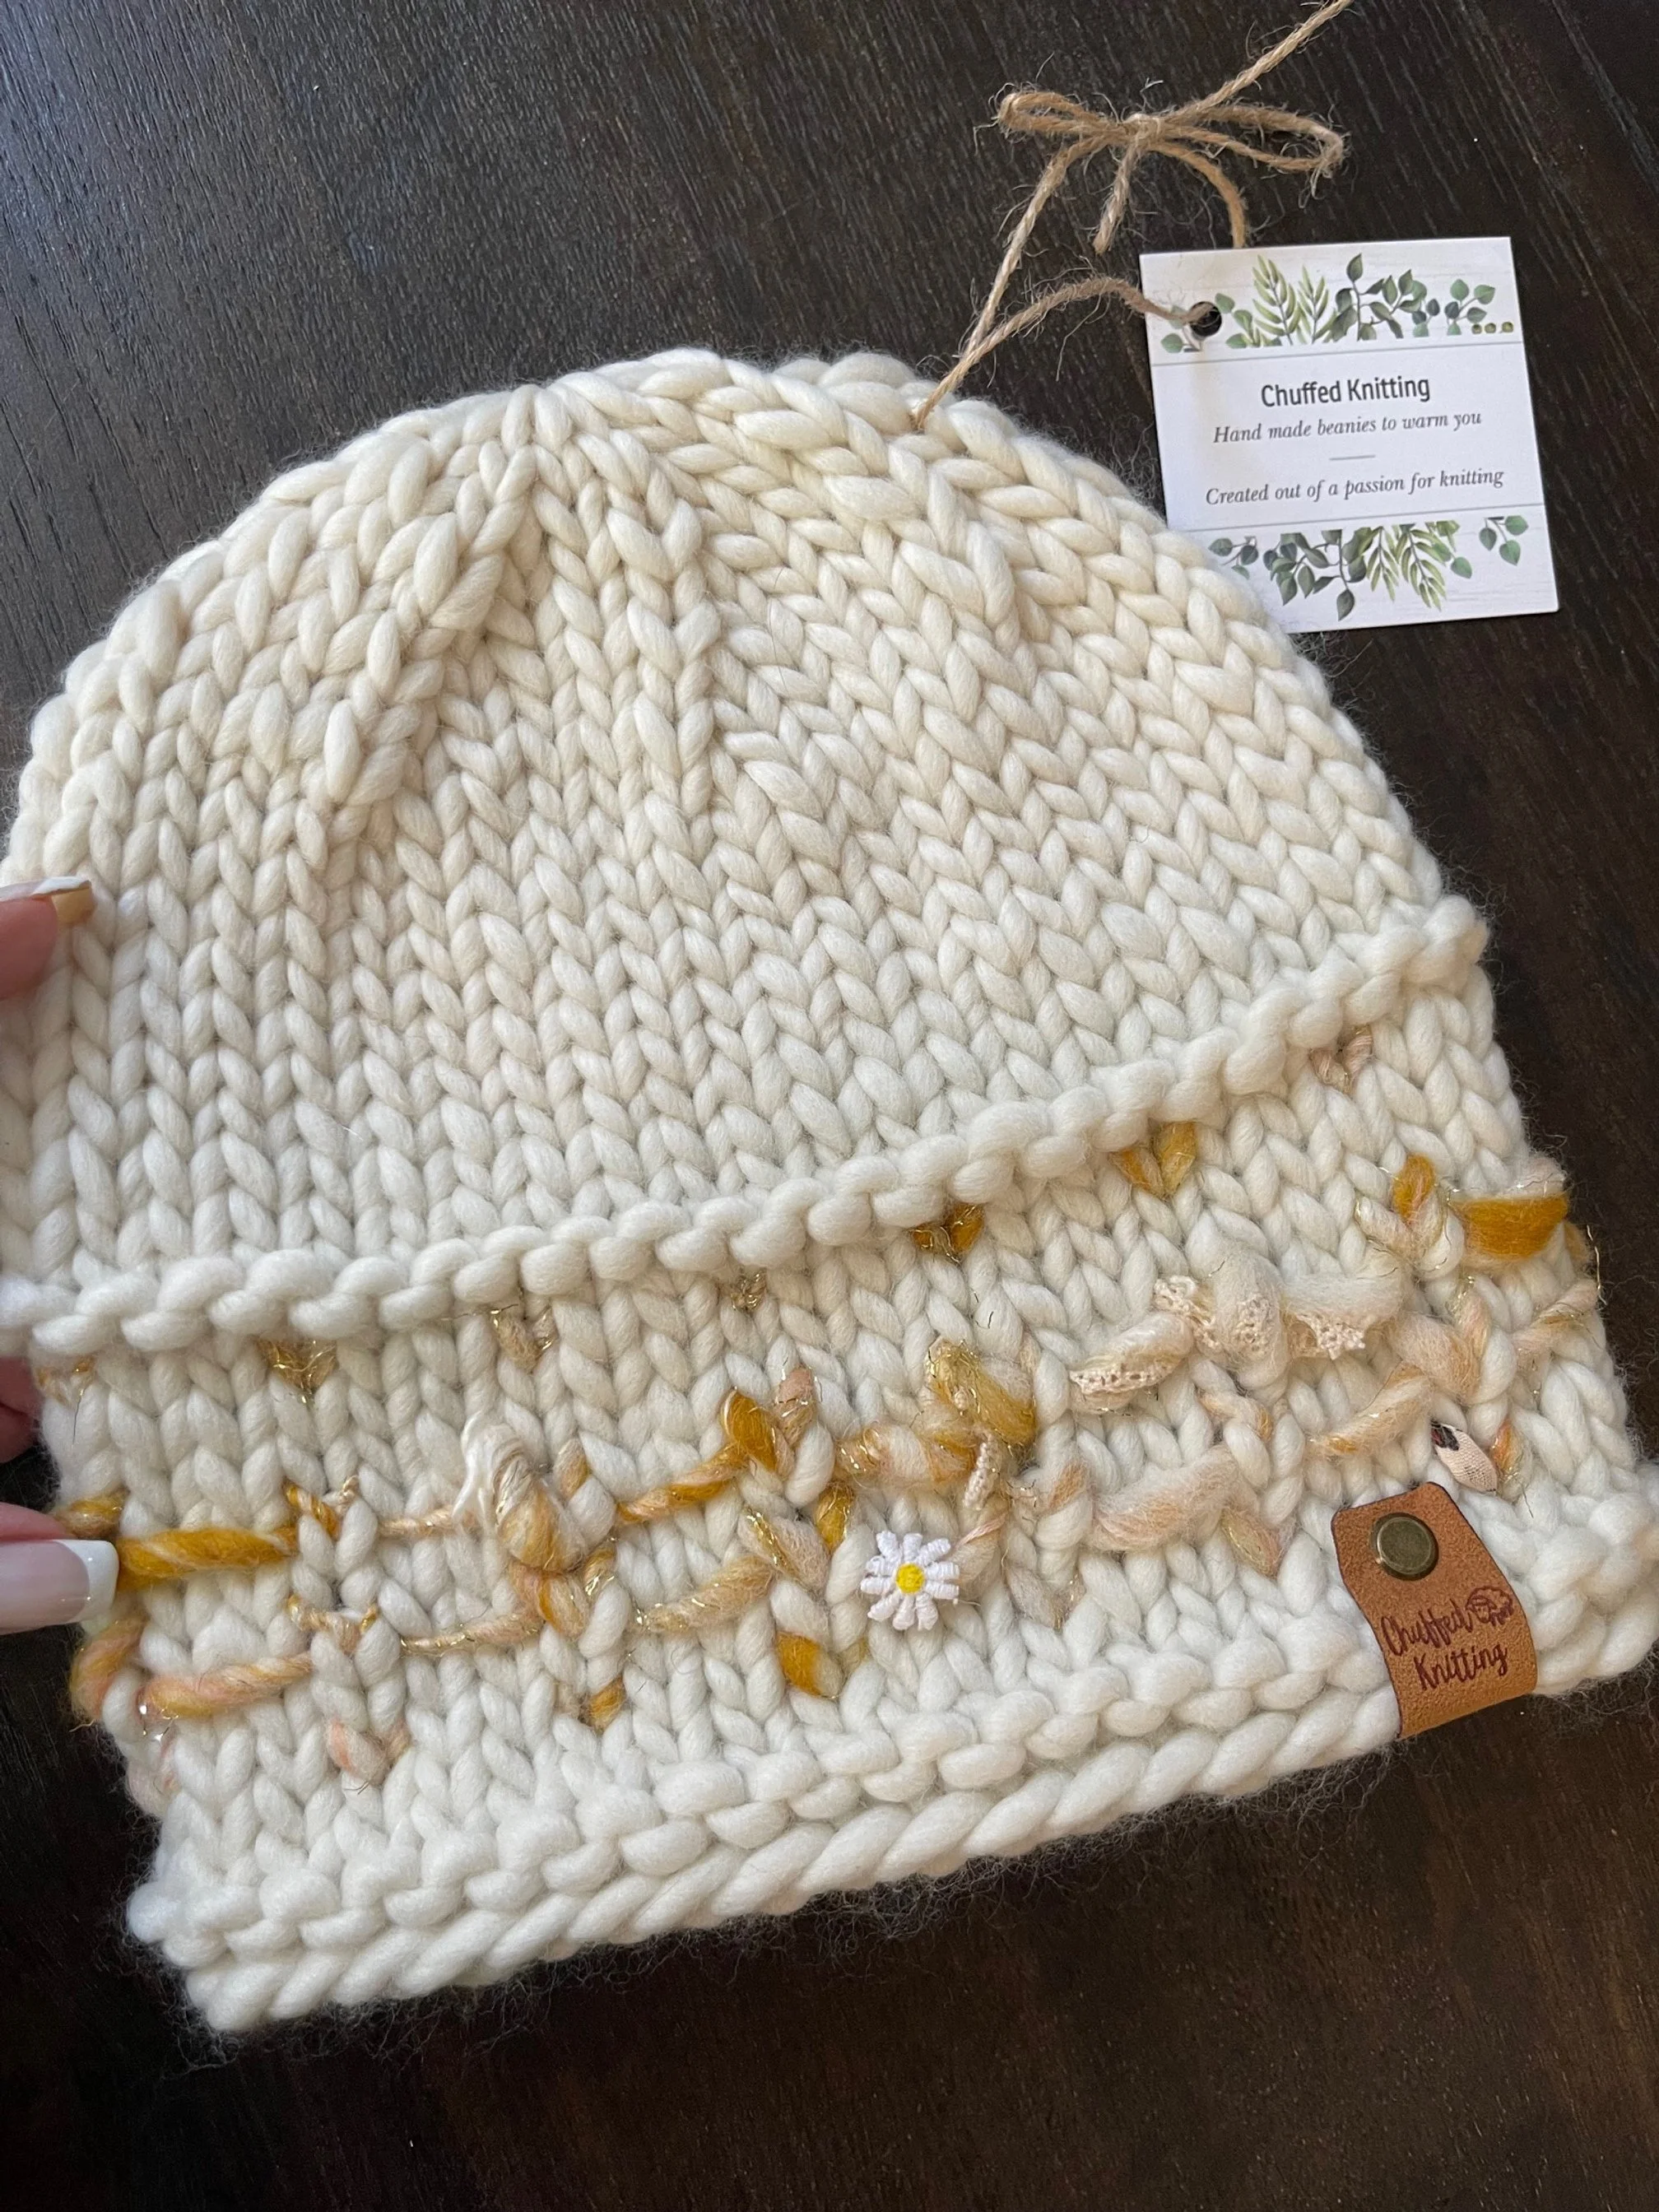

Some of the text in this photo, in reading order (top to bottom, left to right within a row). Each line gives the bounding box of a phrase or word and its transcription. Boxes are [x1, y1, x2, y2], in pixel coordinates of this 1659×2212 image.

[1261, 375, 1430, 407] Chuffed Knitting
[1213, 411, 1481, 444] Hand made beanies to warm you
[1206, 469, 1504, 505] Created out of a passion for knitting
[1380, 1599, 1473, 1657] Chuffed
[1413, 1643, 1508, 1691] Knitting
